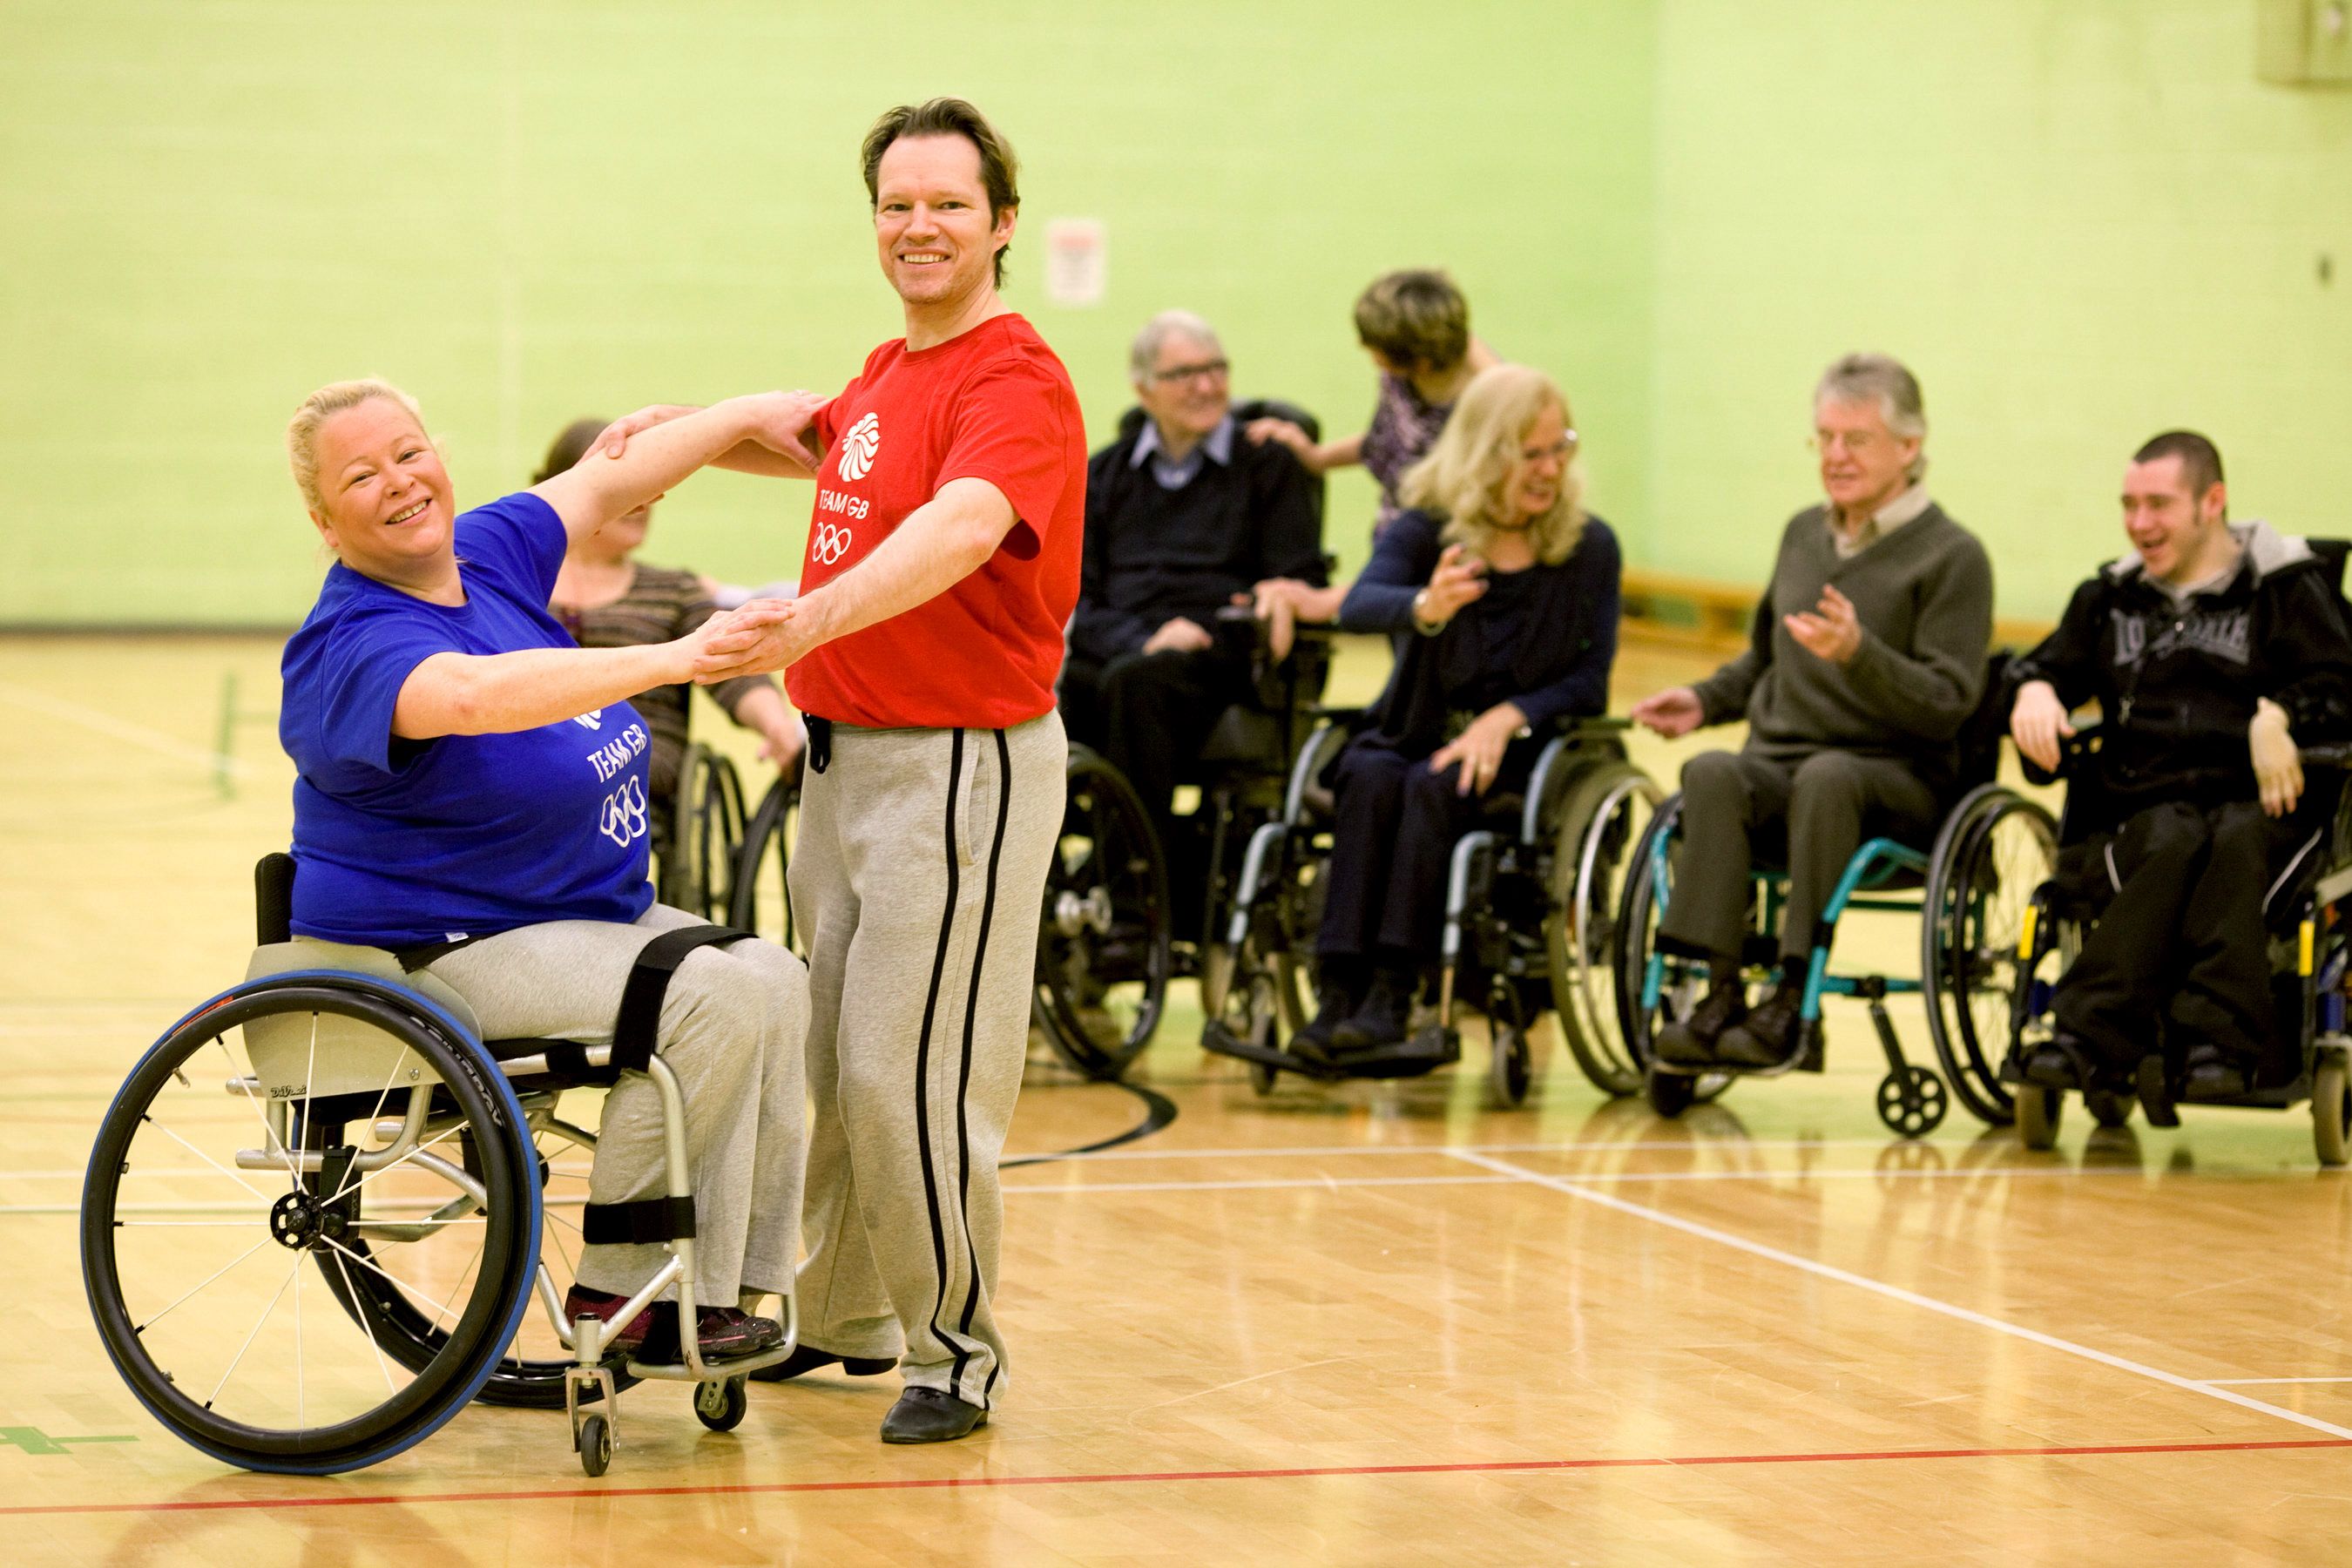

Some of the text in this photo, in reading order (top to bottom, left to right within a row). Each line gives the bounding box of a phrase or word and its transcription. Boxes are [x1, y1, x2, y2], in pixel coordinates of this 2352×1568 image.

[819, 490, 869, 520] TEAM GB
[586, 723, 647, 783] TEAM GB
